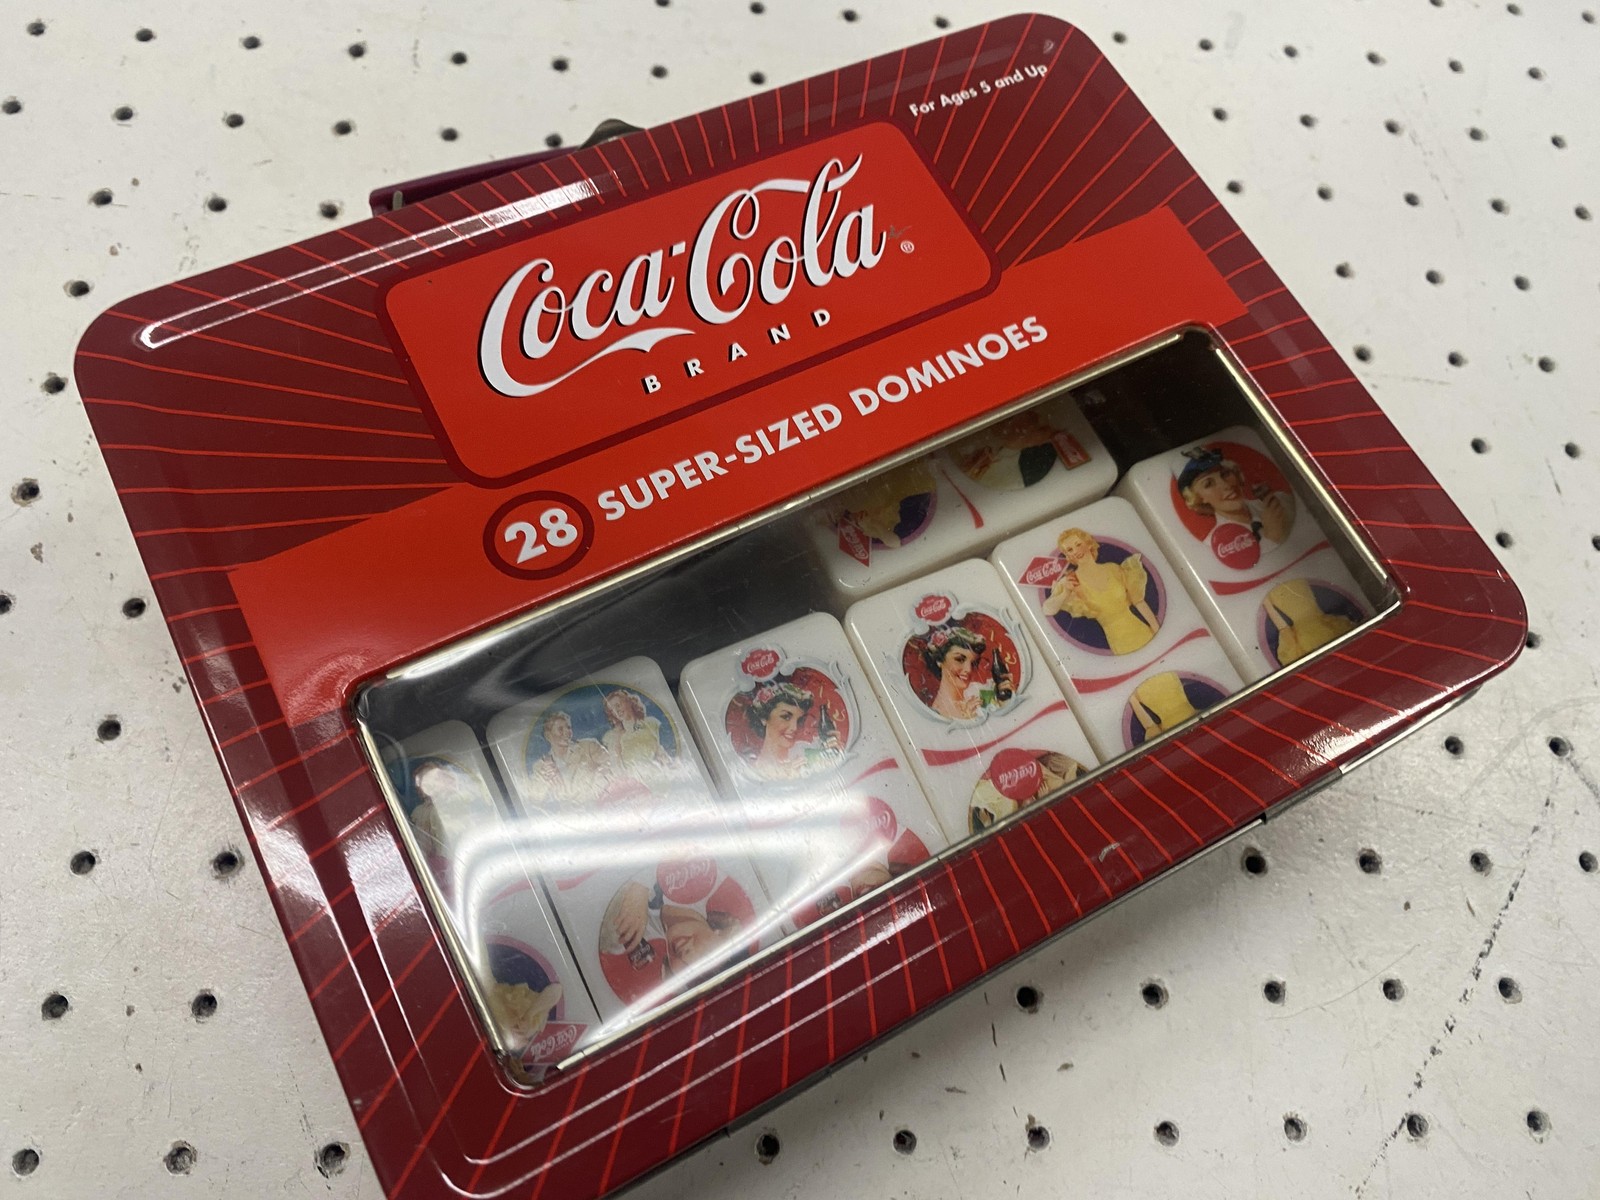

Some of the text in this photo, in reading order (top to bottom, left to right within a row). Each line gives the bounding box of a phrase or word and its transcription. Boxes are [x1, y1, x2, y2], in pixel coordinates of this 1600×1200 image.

[908, 64, 1048, 117] For Ages 5 and Up
[478, 153, 888, 398] Coca-Cola
[642, 309, 832, 395] BRAND
[503, 316, 1049, 564] 28 SUPER-SIZED DOMINOES
